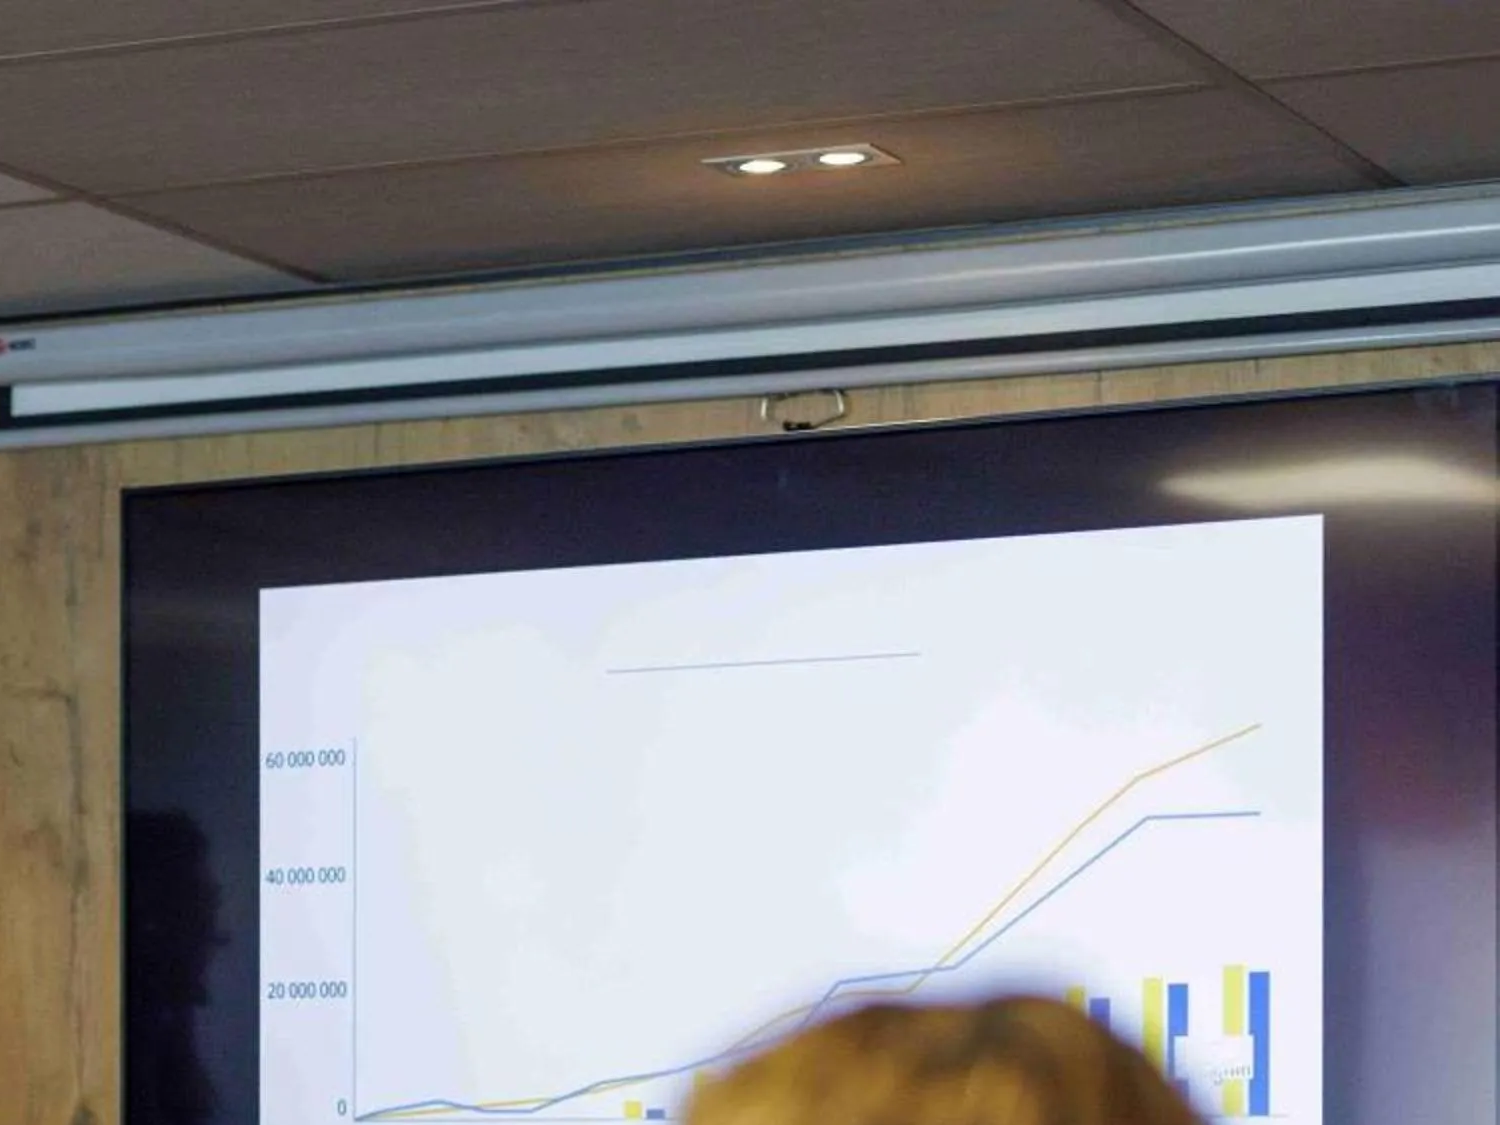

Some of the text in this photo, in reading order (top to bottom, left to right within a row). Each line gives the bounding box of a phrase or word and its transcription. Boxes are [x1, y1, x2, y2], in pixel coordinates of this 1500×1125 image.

[265, 748, 346, 769] 60 000 000
[264, 866, 347, 886] 40 000 000
[267, 980, 348, 1000] 20 000 000
[337, 1098, 347, 1116] 0
